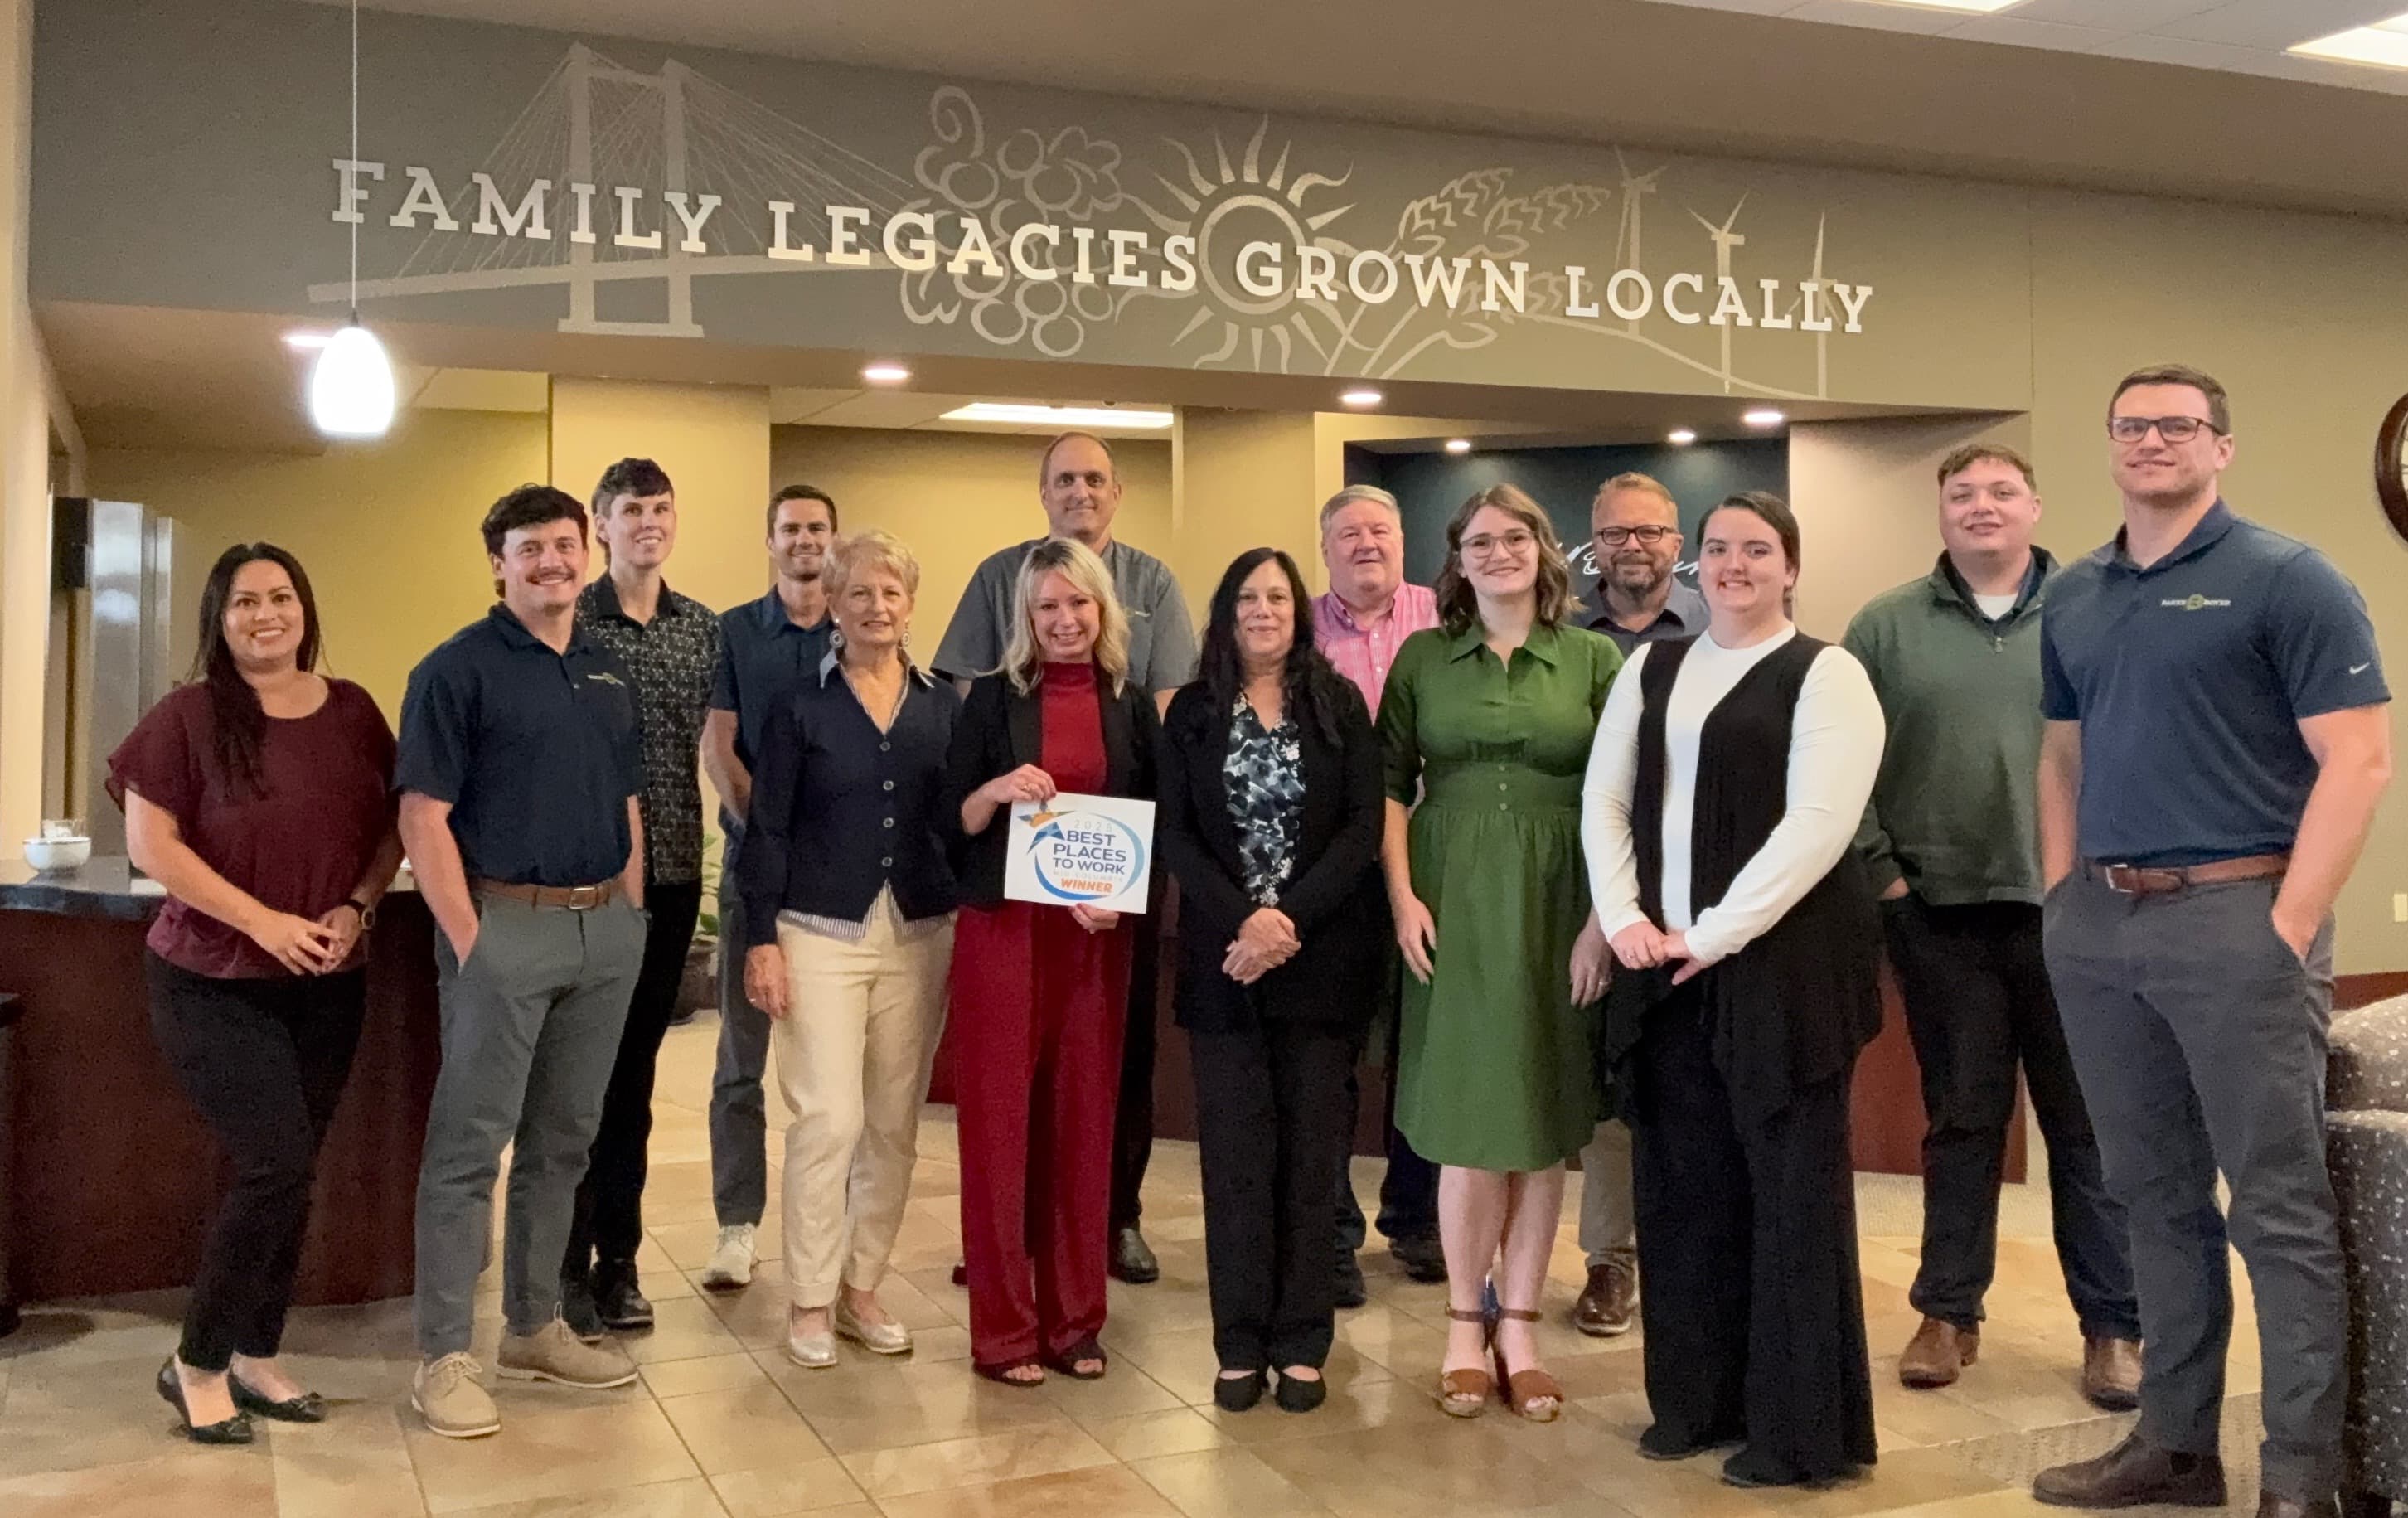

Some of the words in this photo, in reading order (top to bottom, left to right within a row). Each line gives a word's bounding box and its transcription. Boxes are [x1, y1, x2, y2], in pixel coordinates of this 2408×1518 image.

[332, 158, 721, 253] FAMILY
[768, 201, 1197, 291] LEGACIES
[1235, 240, 1529, 313] GROWN
[1564, 265, 1873, 333] LOCALLY
[1067, 830, 1116, 846] BEST
[1053, 843, 1126, 862] PLACES
[1053, 857, 1073, 870] TO
[1078, 860, 1125, 875] WORK
[1060, 877, 1112, 893] WINNER
